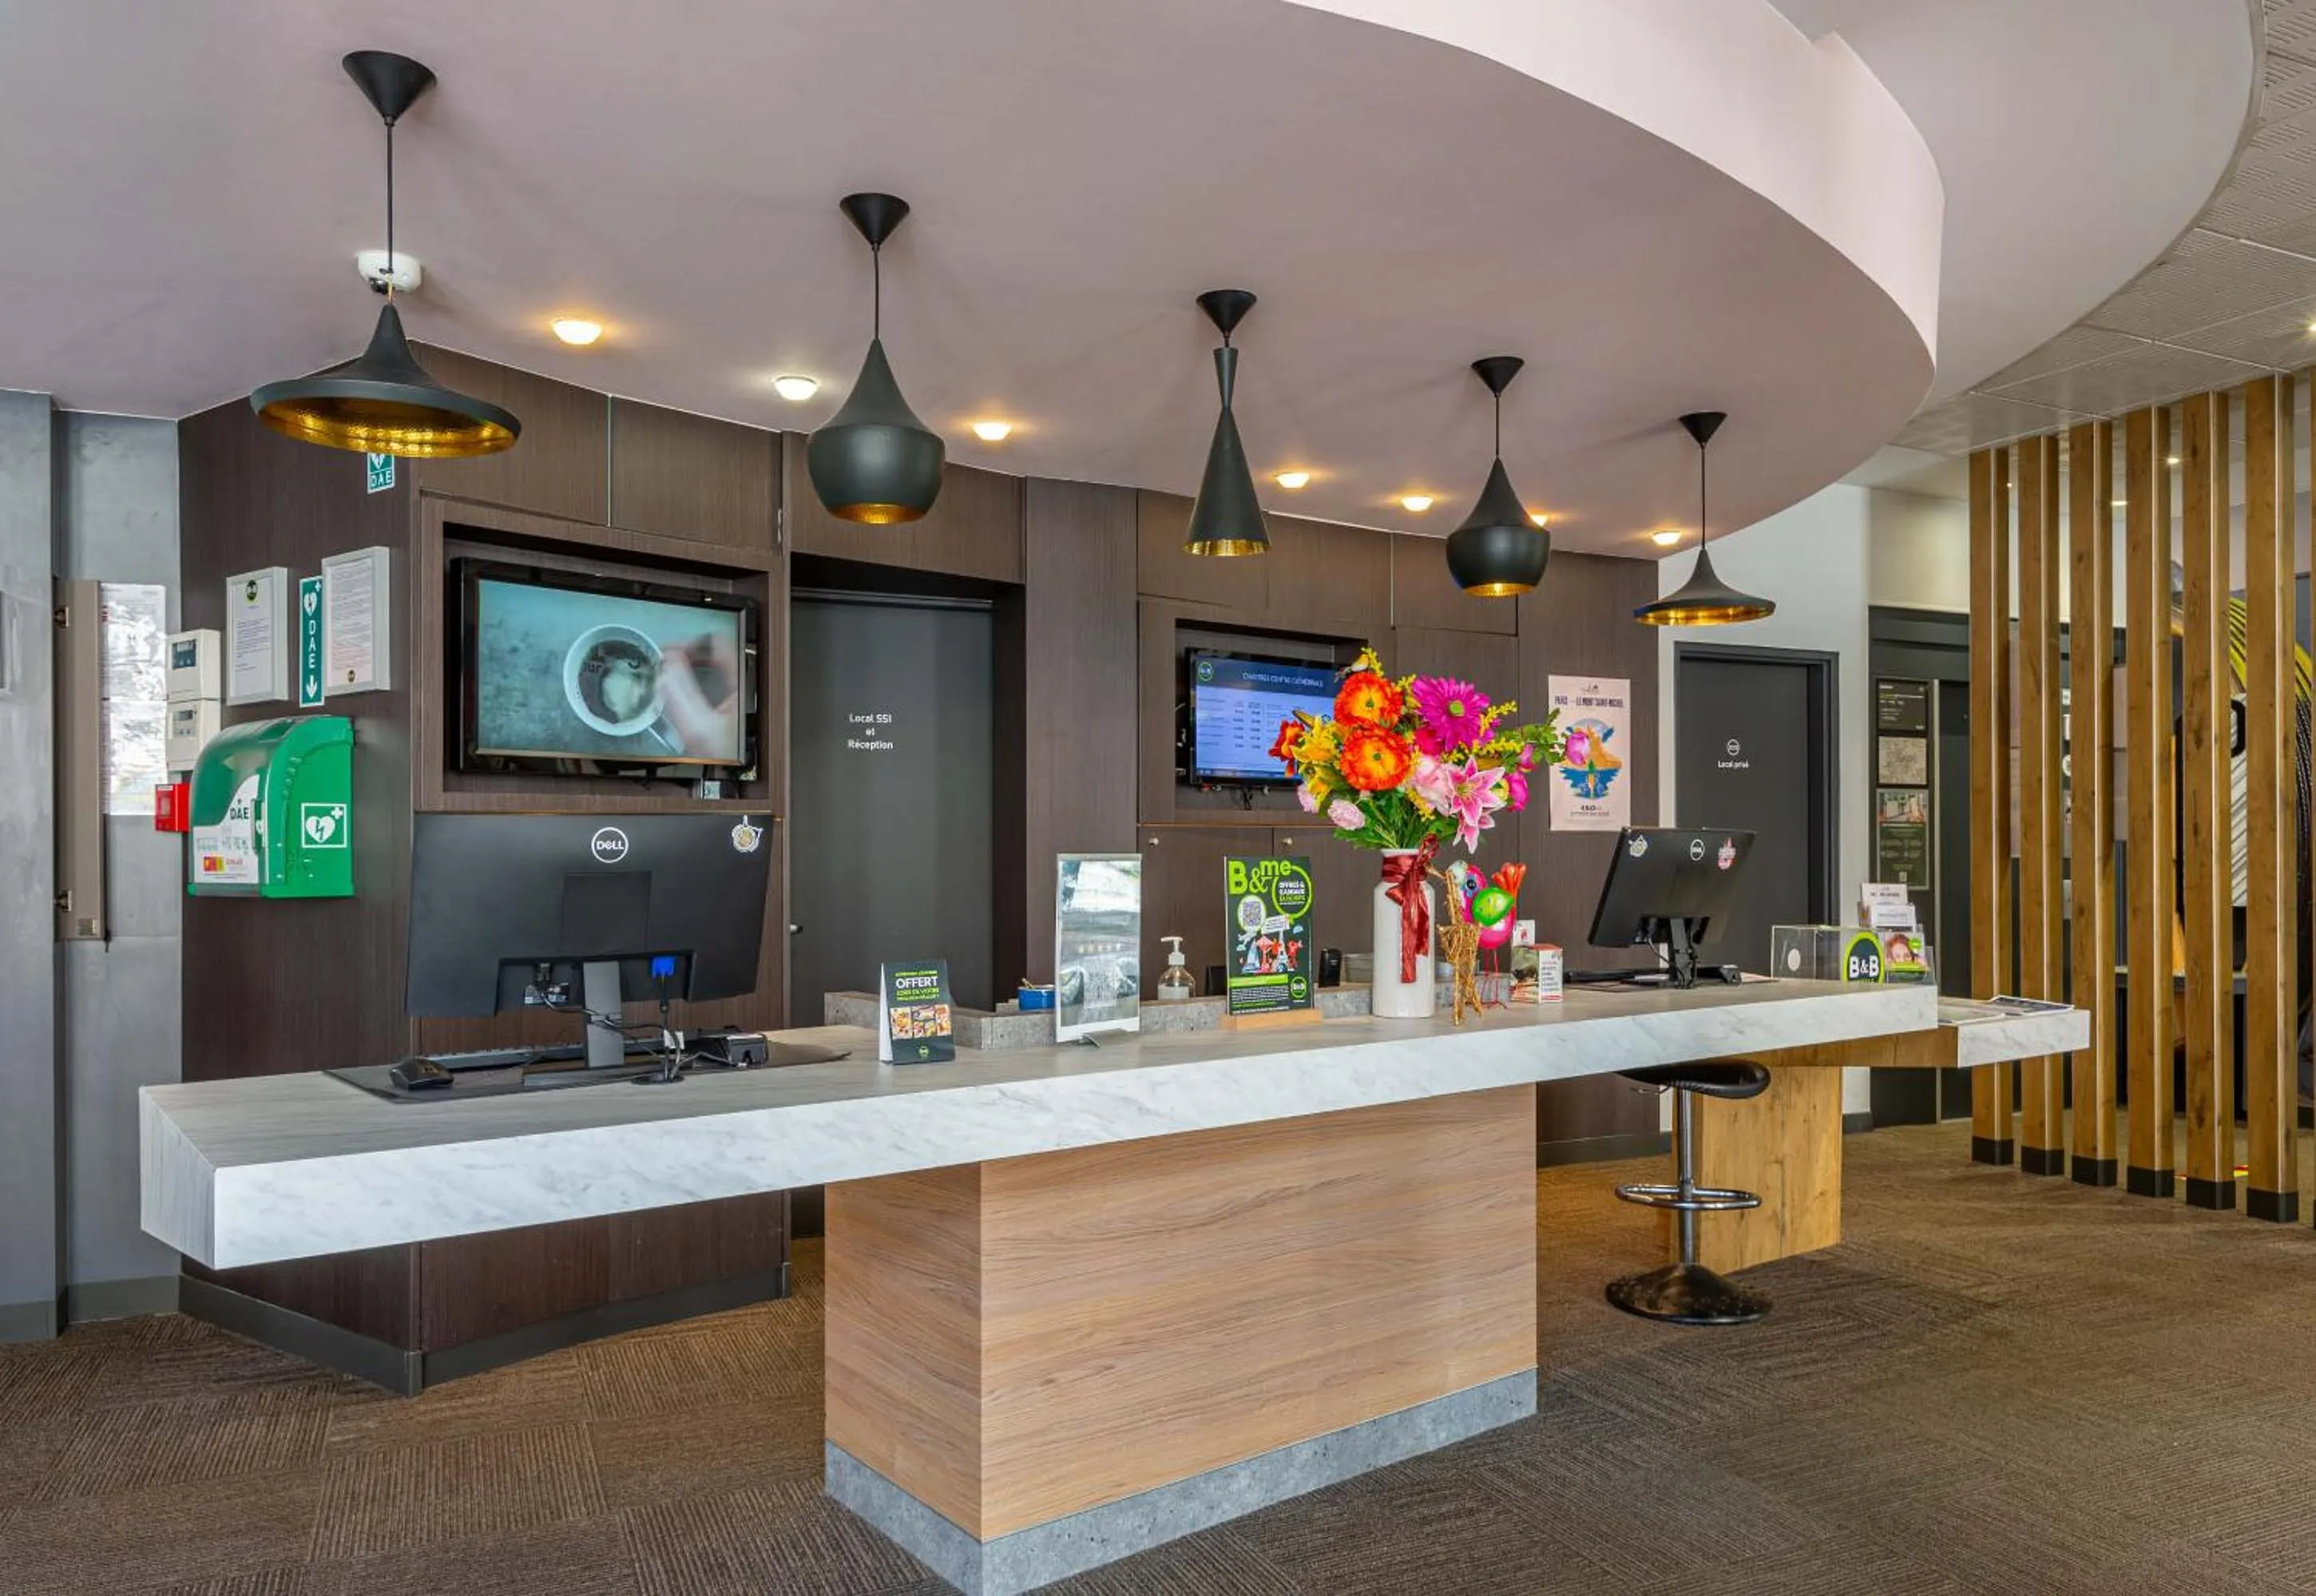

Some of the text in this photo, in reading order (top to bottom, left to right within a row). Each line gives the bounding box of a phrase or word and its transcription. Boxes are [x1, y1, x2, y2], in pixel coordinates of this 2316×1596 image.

[370, 470, 392, 487] DAE
[308, 620, 317, 669] DAE
[849, 713, 892, 723] Local SSI
[866, 727, 875, 736] et
[848, 739, 894, 751] Réception
[229, 807, 250, 821] DAE
[596, 840, 625, 850] DELL
[1849, 954, 1880, 979] B&B
[895, 976, 938, 989] OFFERT
